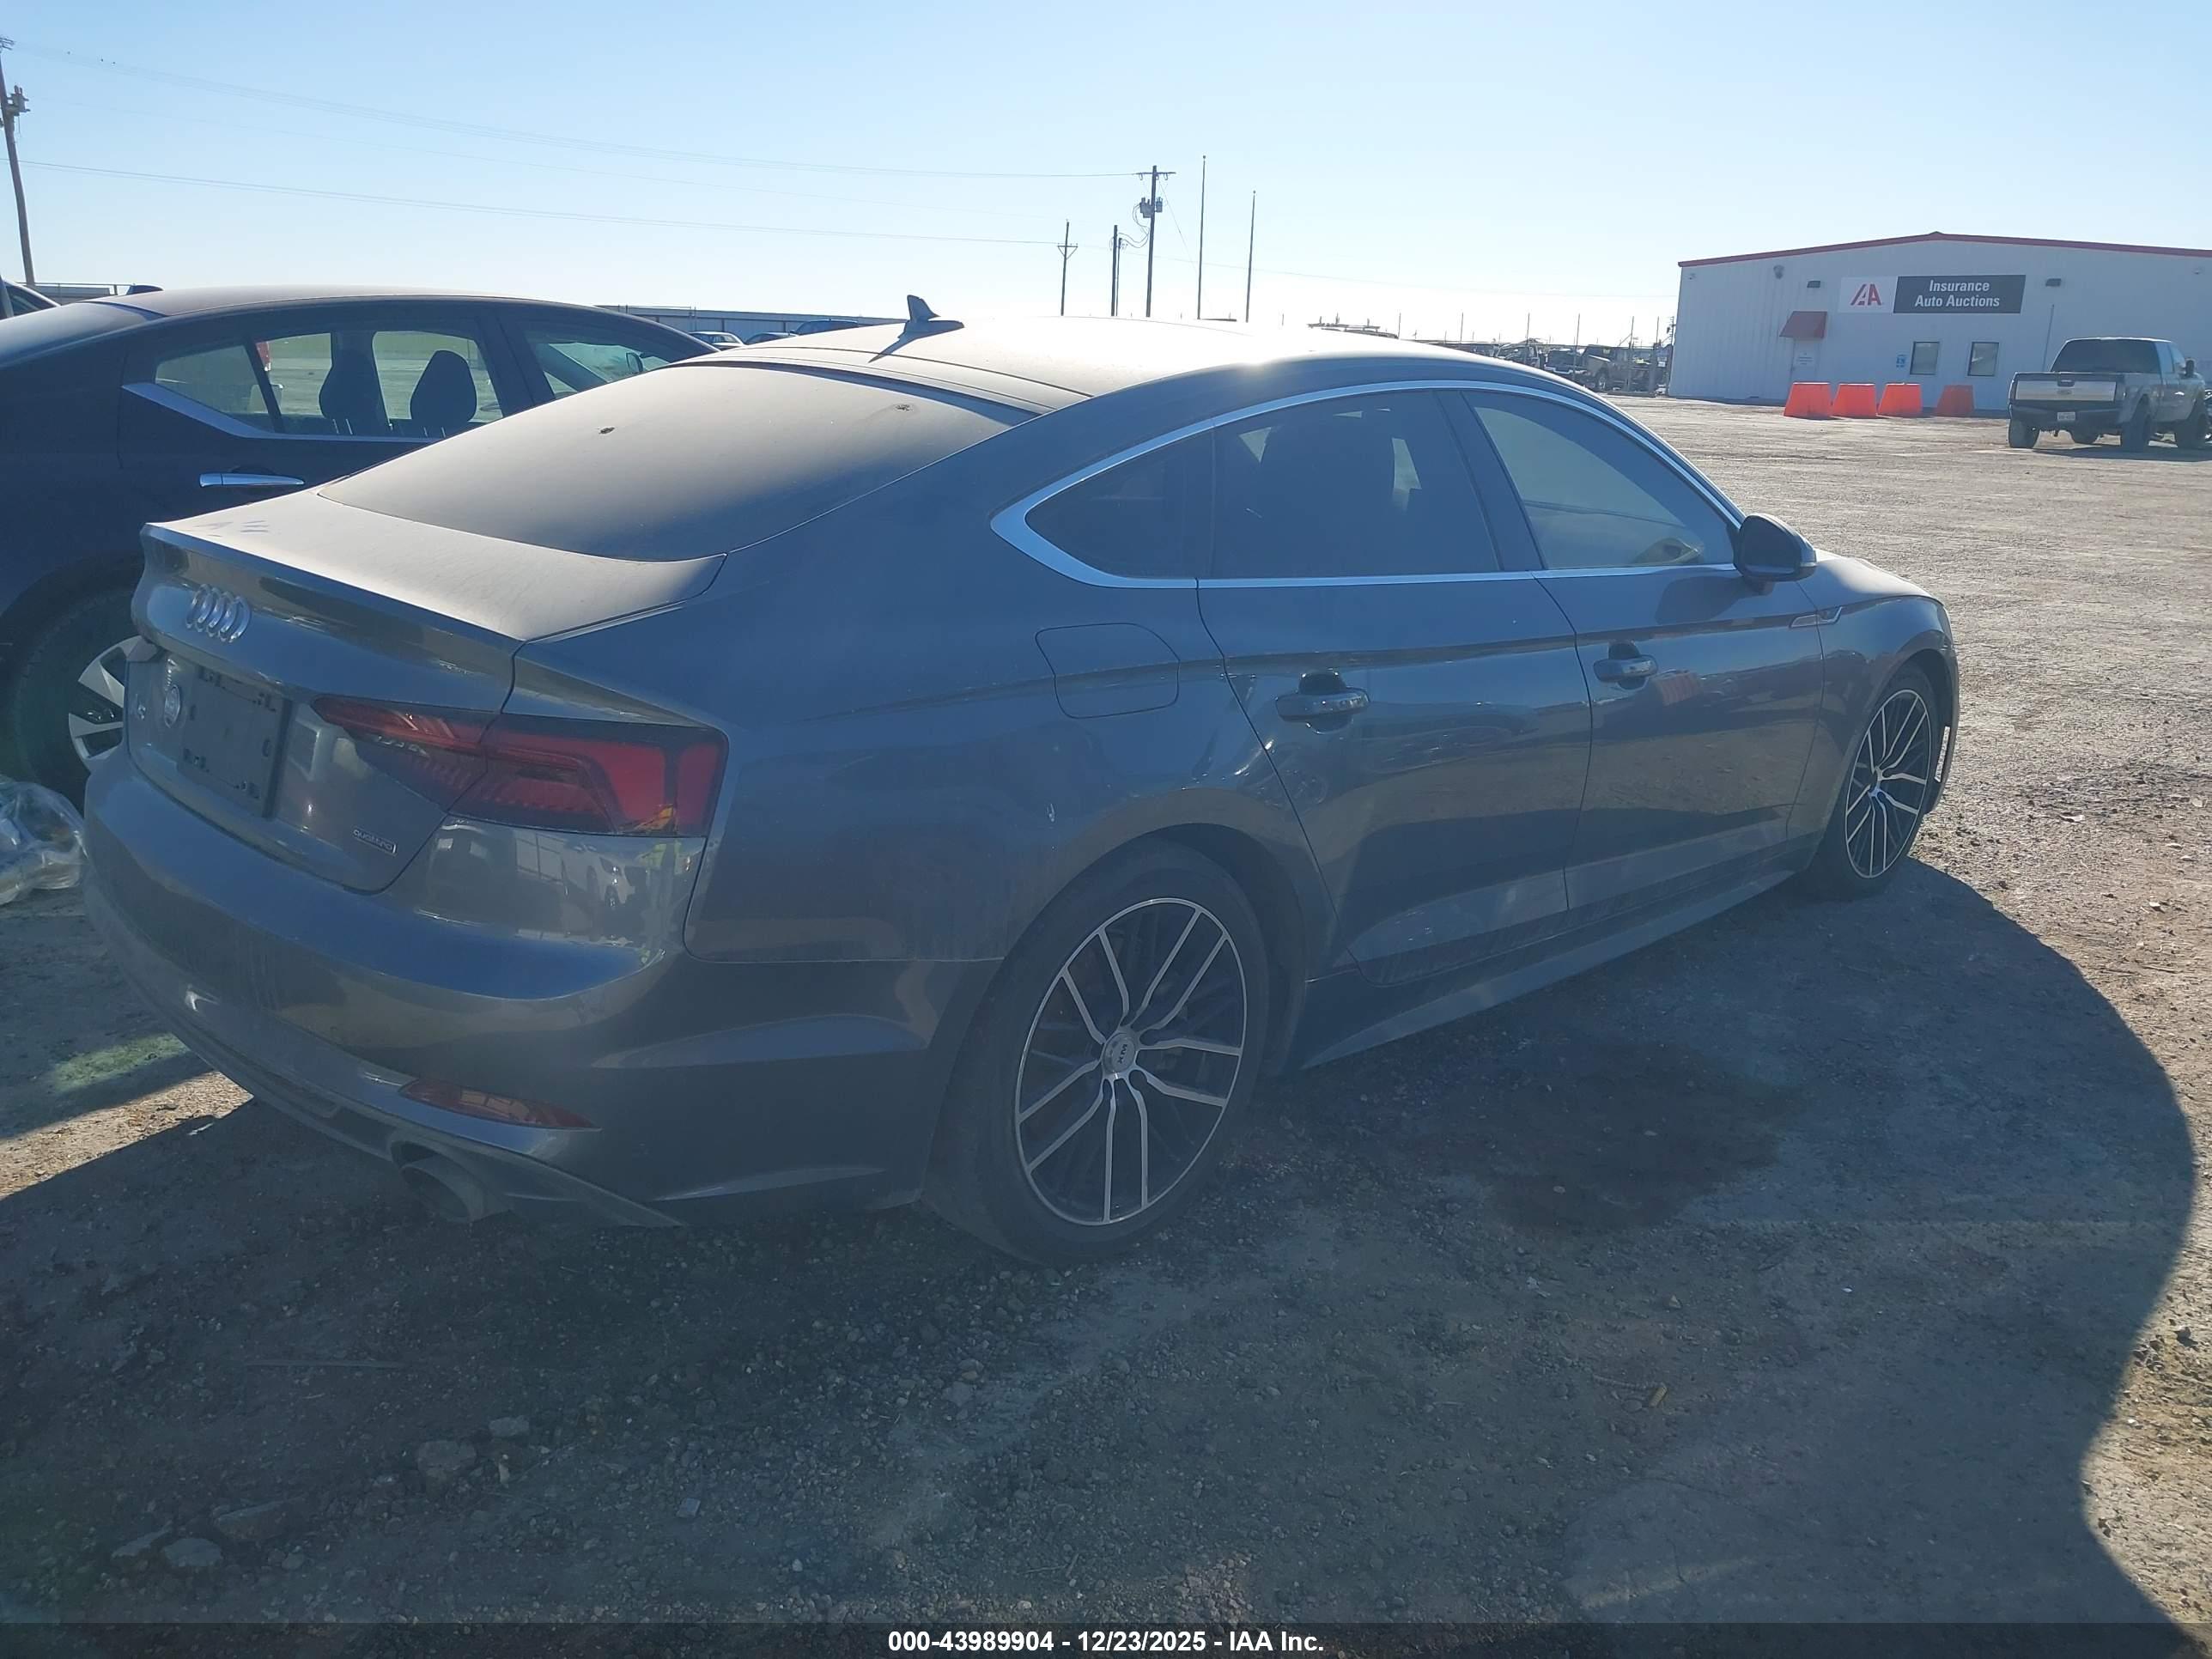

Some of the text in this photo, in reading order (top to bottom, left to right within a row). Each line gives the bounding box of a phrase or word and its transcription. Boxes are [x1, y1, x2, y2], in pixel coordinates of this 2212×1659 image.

[1929, 279, 1990, 292] Insurance
[1914, 294, 2001, 307] Auto Auctions
